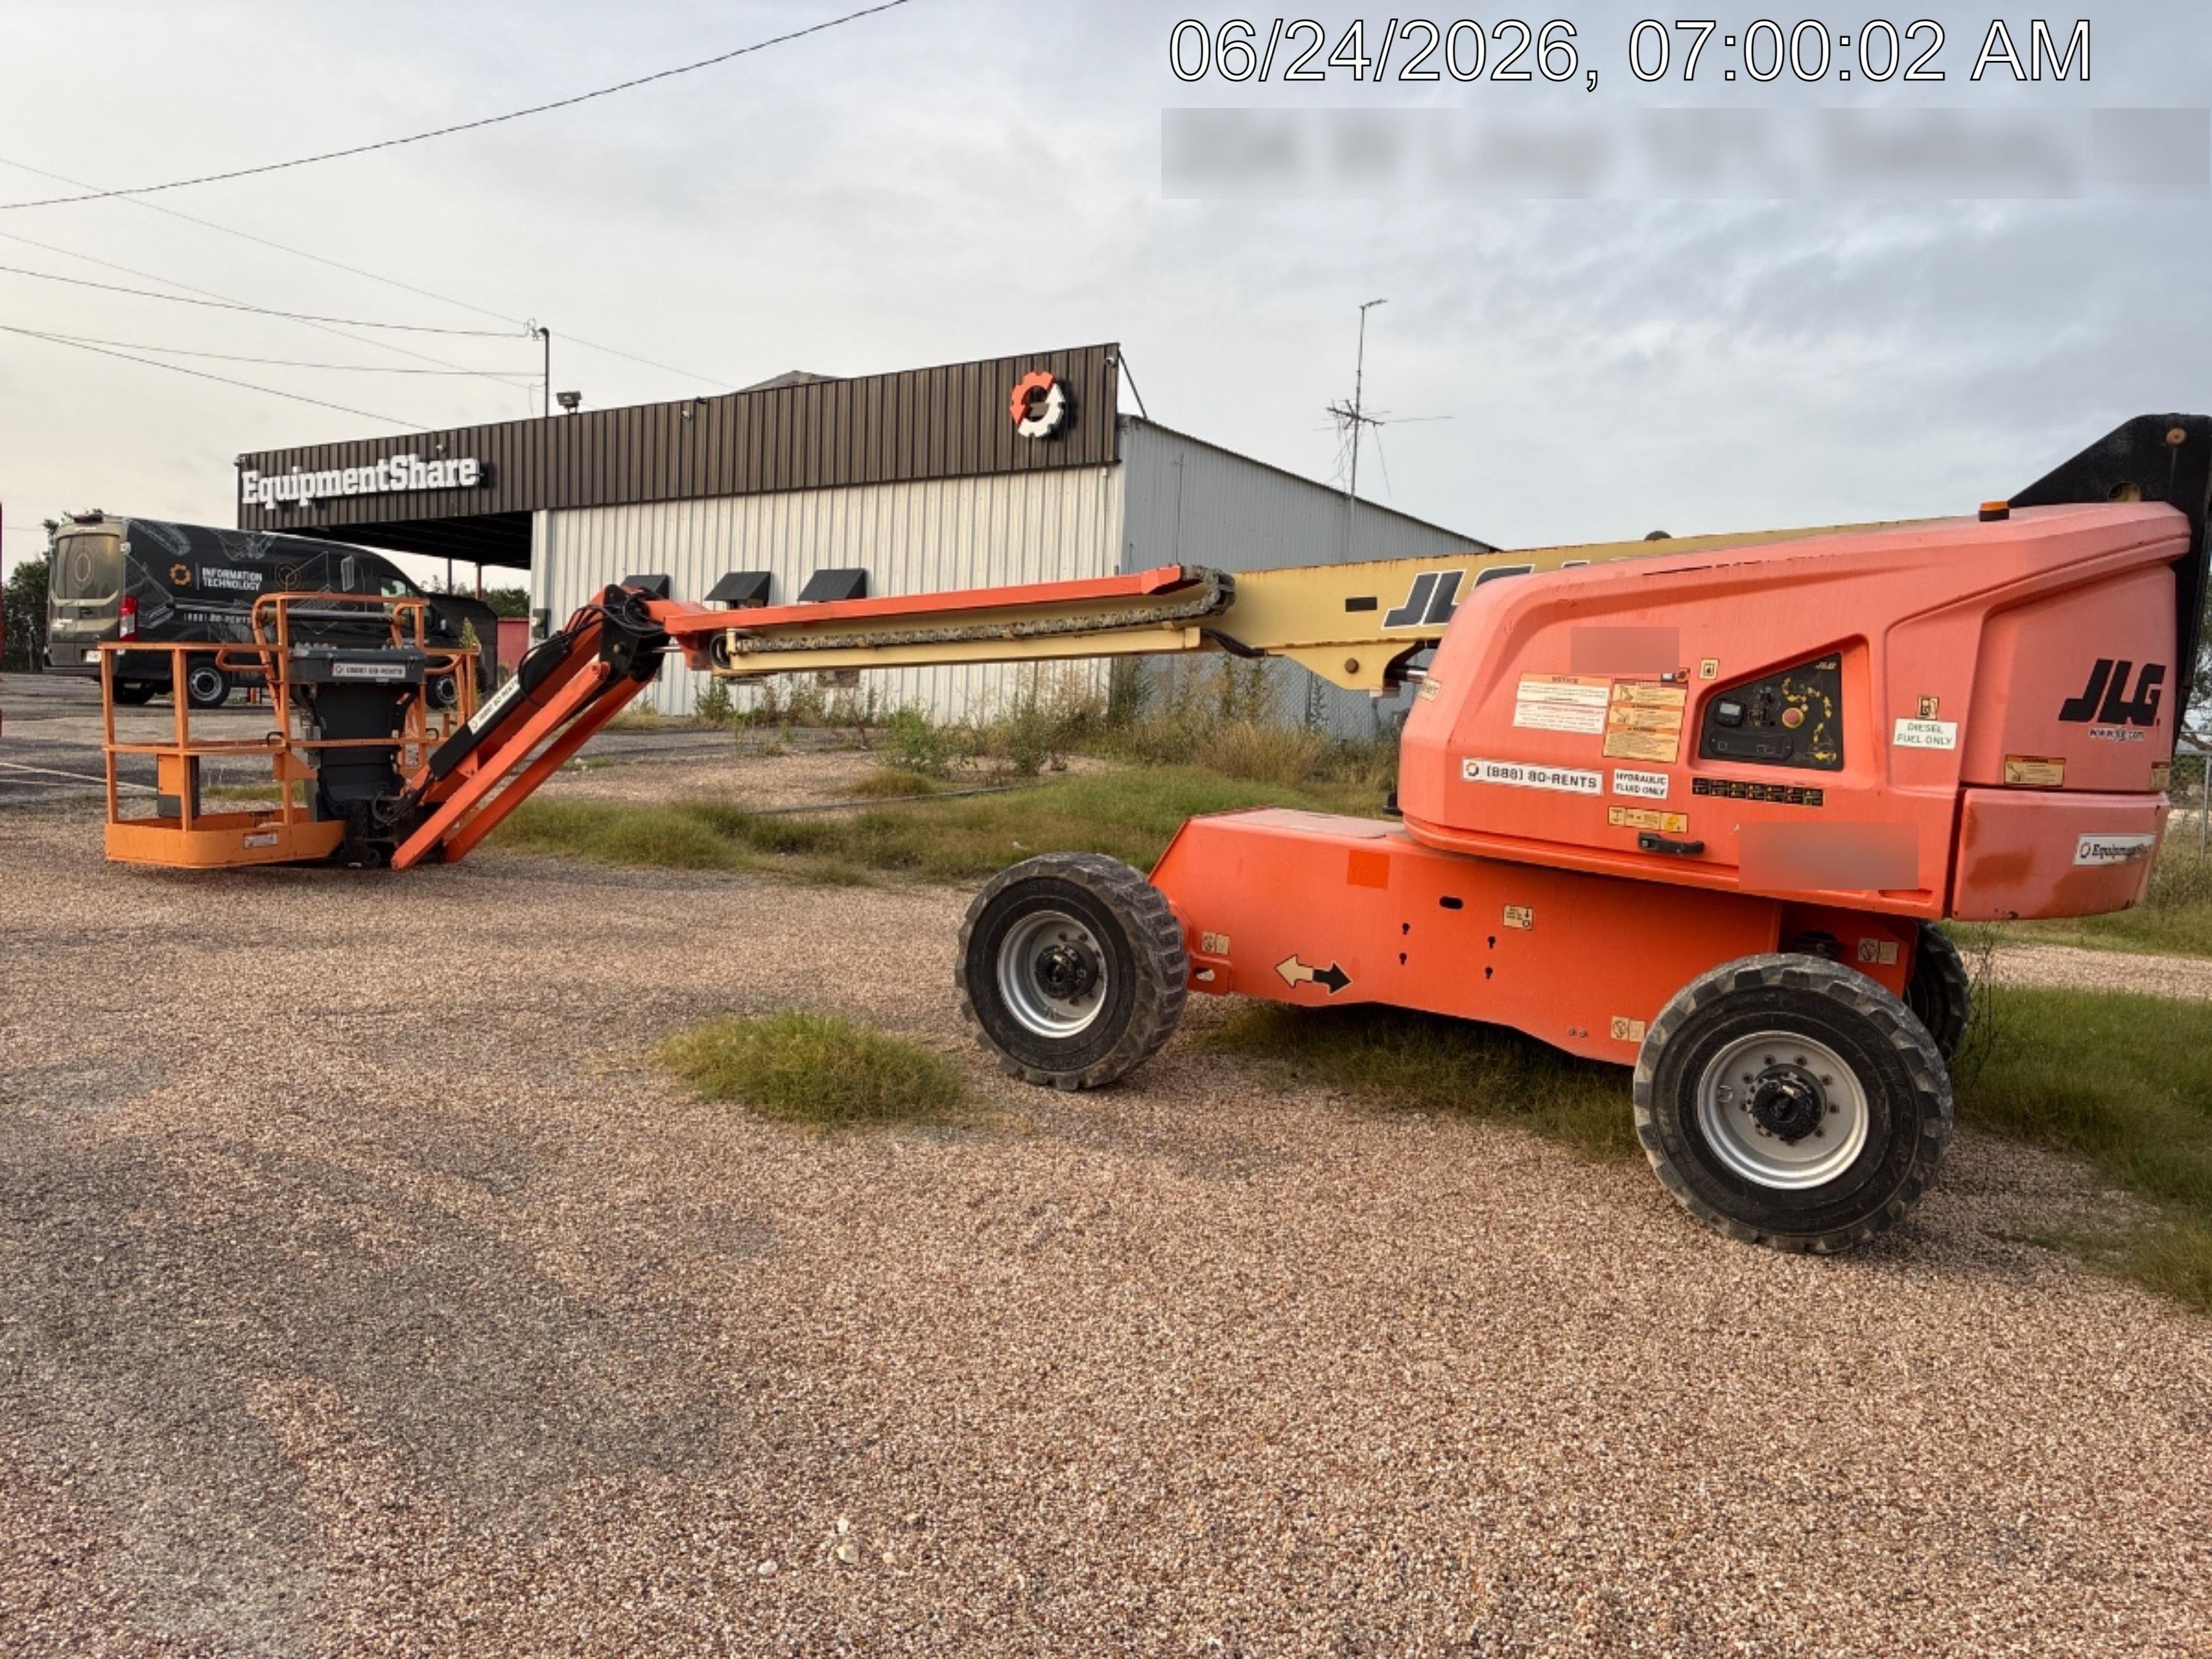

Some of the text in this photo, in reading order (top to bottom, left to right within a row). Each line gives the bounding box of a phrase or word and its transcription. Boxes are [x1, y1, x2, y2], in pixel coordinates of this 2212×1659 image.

[241, 453, 480, 509] EquipmentShare
[202, 567, 262, 582] INFORMATION
[203, 577, 261, 591] TECHNOLOGY
[2058, 658, 2166, 726] JLG
[1907, 723, 1943, 734] DIESEL
[1896, 733, 1952, 745] FUEL ONLY
[1487, 765, 1598, 788] (888) 80-RENTS
[1616, 772, 1667, 785] HYDRAULIC
[1616, 783, 1665, 796] FLUID ONLY
